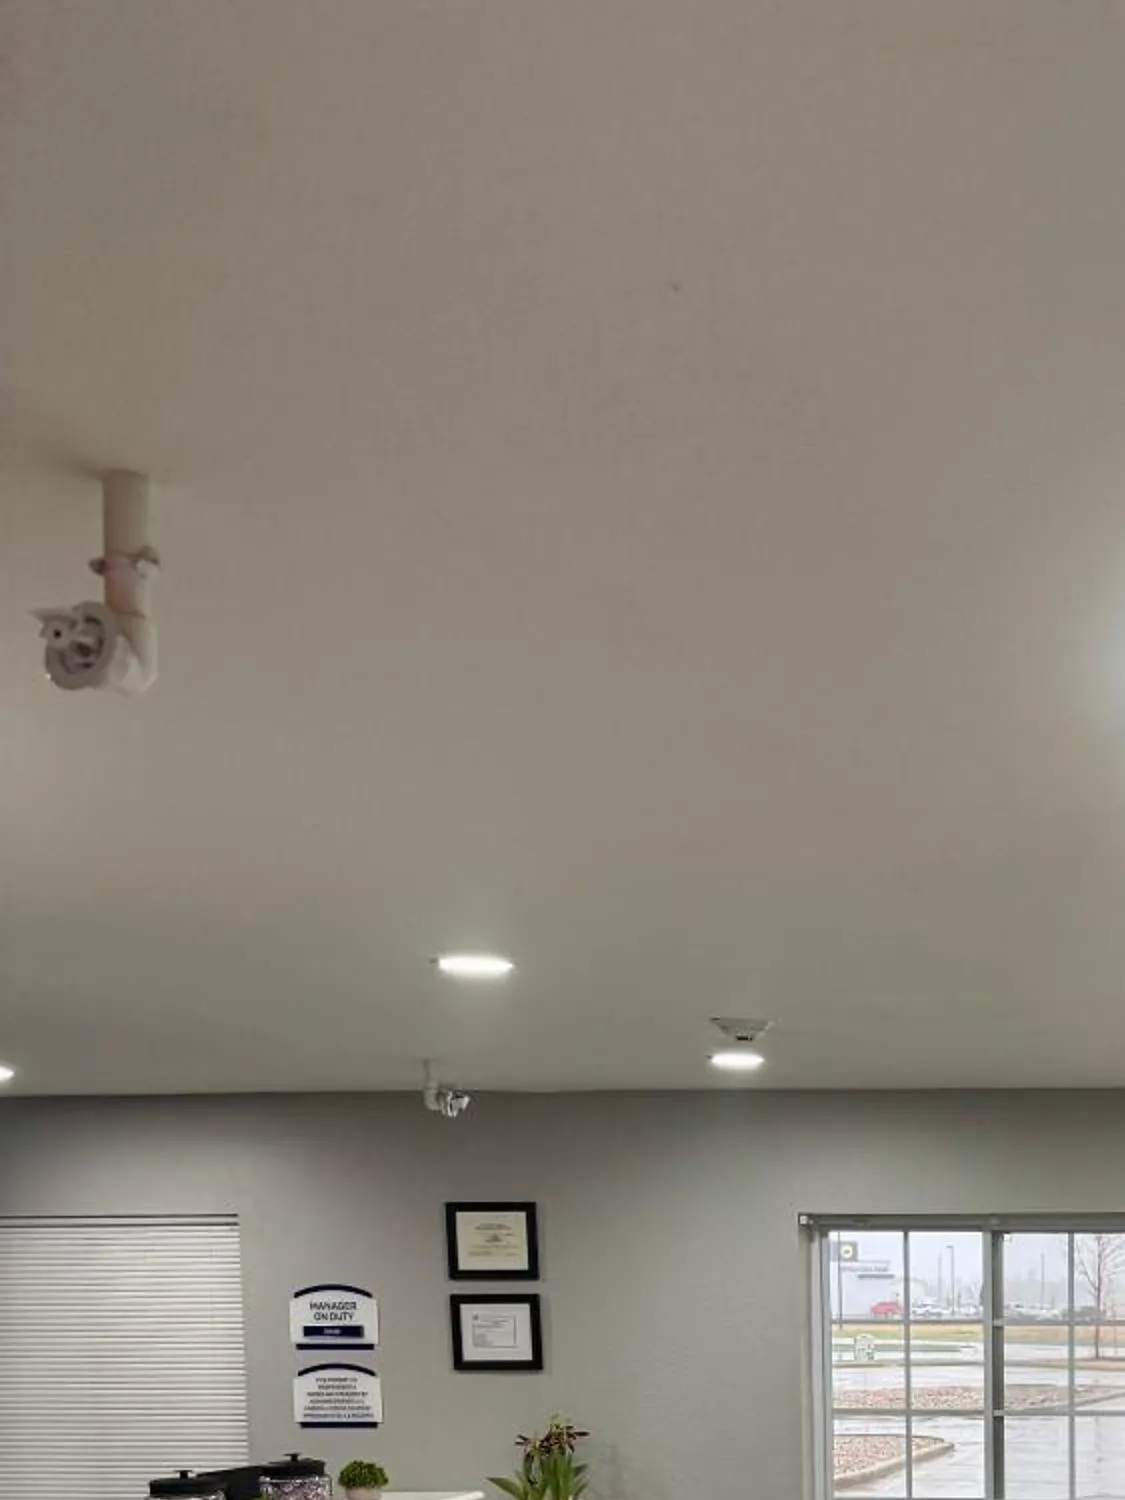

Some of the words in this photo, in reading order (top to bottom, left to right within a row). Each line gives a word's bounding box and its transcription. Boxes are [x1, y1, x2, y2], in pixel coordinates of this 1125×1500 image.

[309, 1301, 357, 1311] MANAGER
[313, 1311, 329, 1321] ON
[329, 1311, 354, 1321] DUTY
